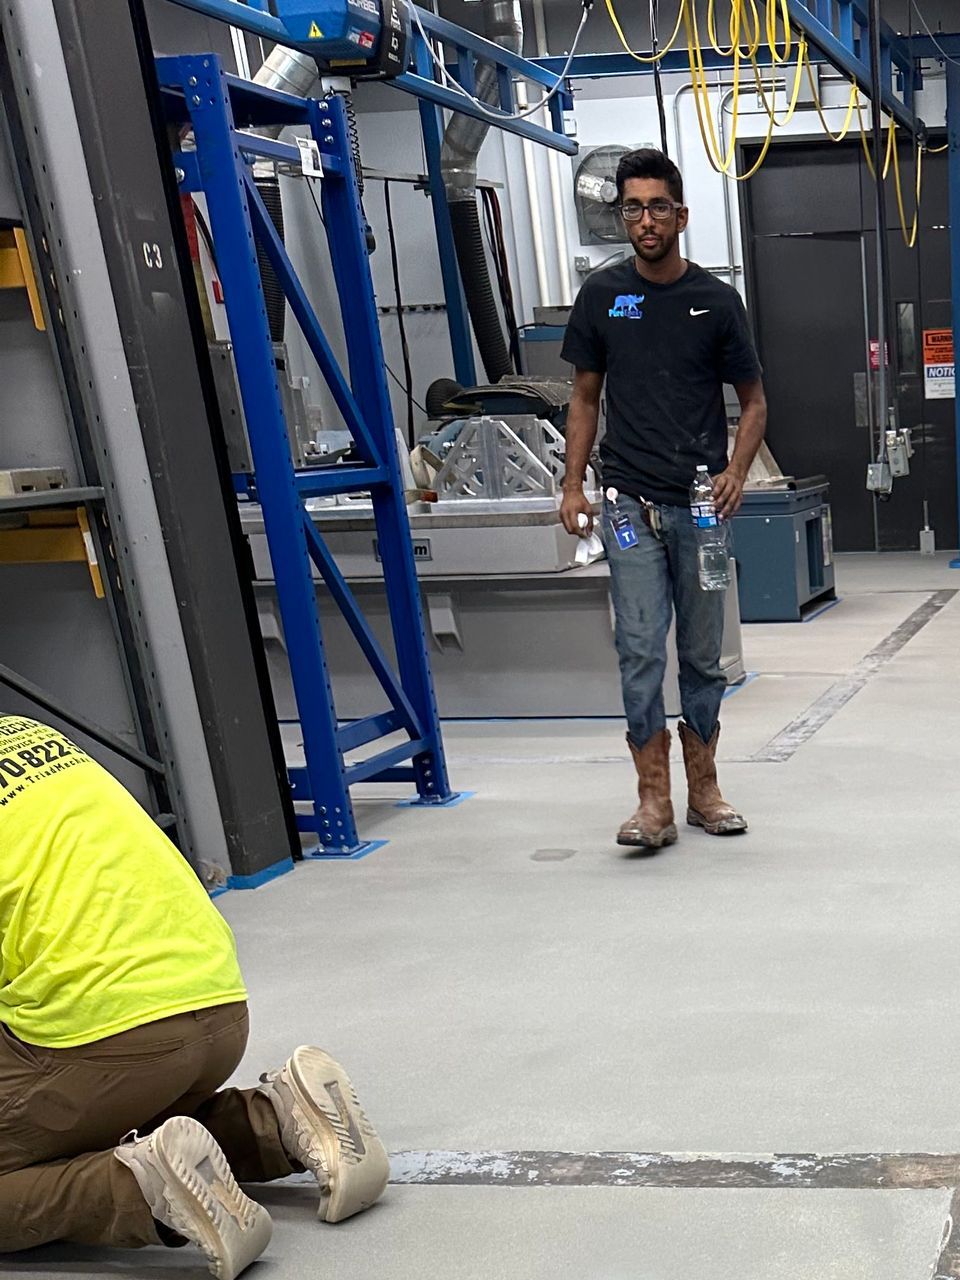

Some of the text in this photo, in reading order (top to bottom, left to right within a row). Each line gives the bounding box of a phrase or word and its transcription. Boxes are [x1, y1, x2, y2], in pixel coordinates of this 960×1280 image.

[931, 335, 952, 343] WARNIN
[928, 367, 955, 377] NOTIC
[0, 757, 90, 806] www.TriadMecha
